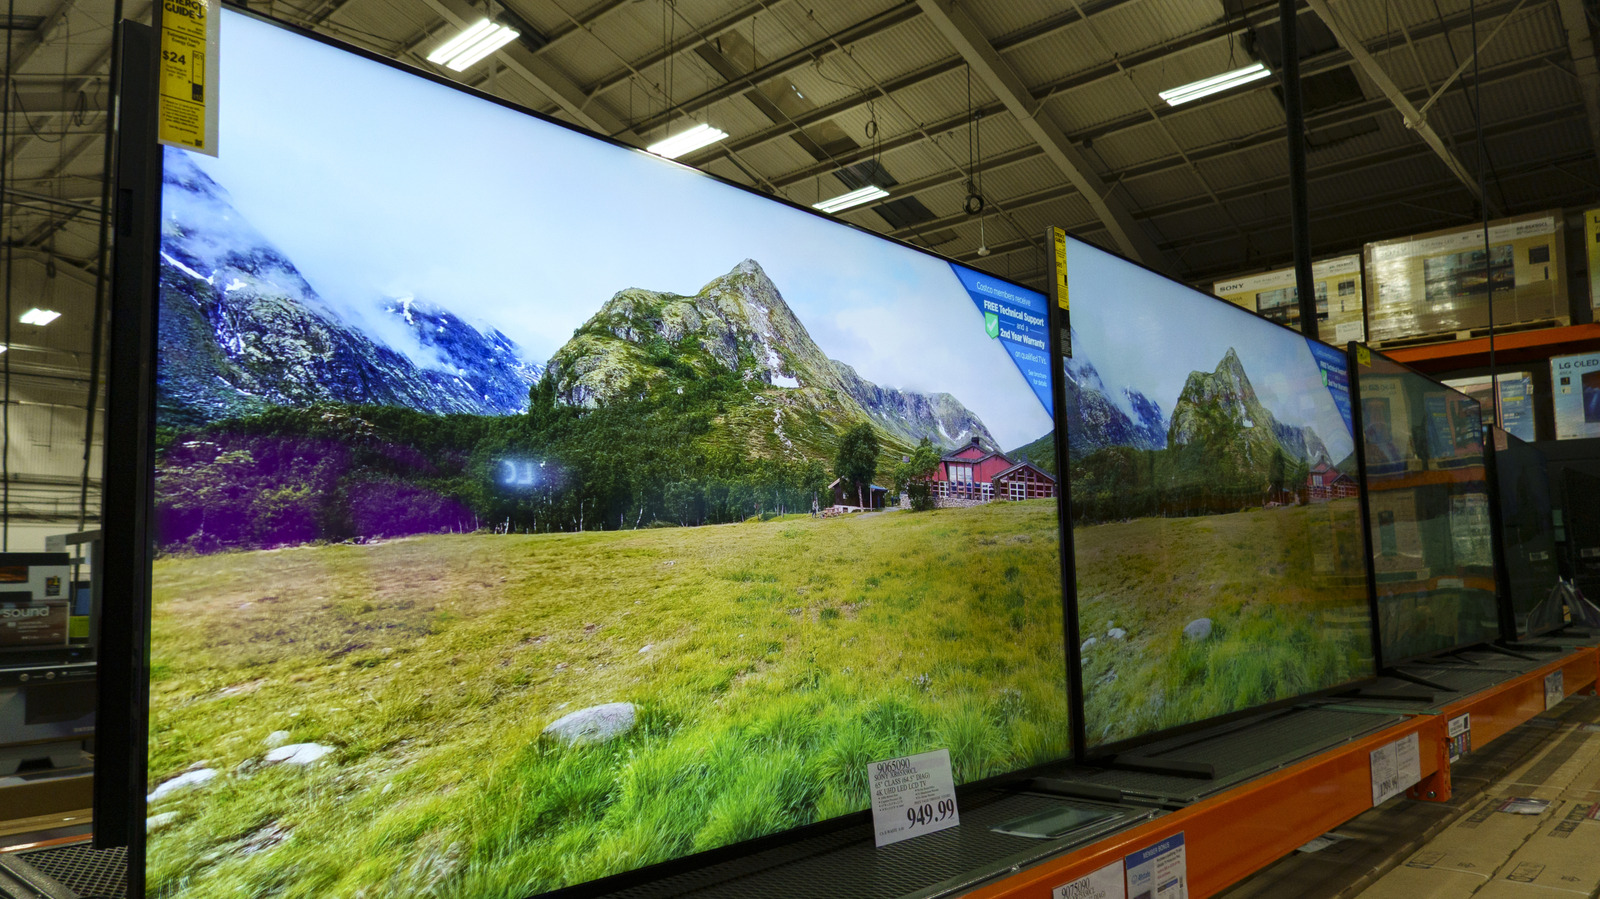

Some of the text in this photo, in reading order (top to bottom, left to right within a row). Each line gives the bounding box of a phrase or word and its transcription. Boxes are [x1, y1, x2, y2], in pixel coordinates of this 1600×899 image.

[165, 2, 195, 19] GUIDE
[162, 50, 186, 65] $24
[976, 281, 1031, 306] Costco members receive
[1219, 283, 1244, 292] SONY
[983, 300, 1044, 327] FREE Technical Support
[1016, 323, 1024, 331] and
[1000, 328, 1045, 349] 2nd Year Warranty
[1559, 359, 1599, 370] LG OLED
[877, 758, 911, 774] 9065090
[874, 772, 888, 782] SONY
[884, 778, 900, 787] CLASS
[884, 786, 896, 795] UHD
[896, 783, 908, 792] LED
[908, 781, 919, 790] LCD
[920, 780, 927, 788] TV
[907, 798, 954, 829] 949.99
